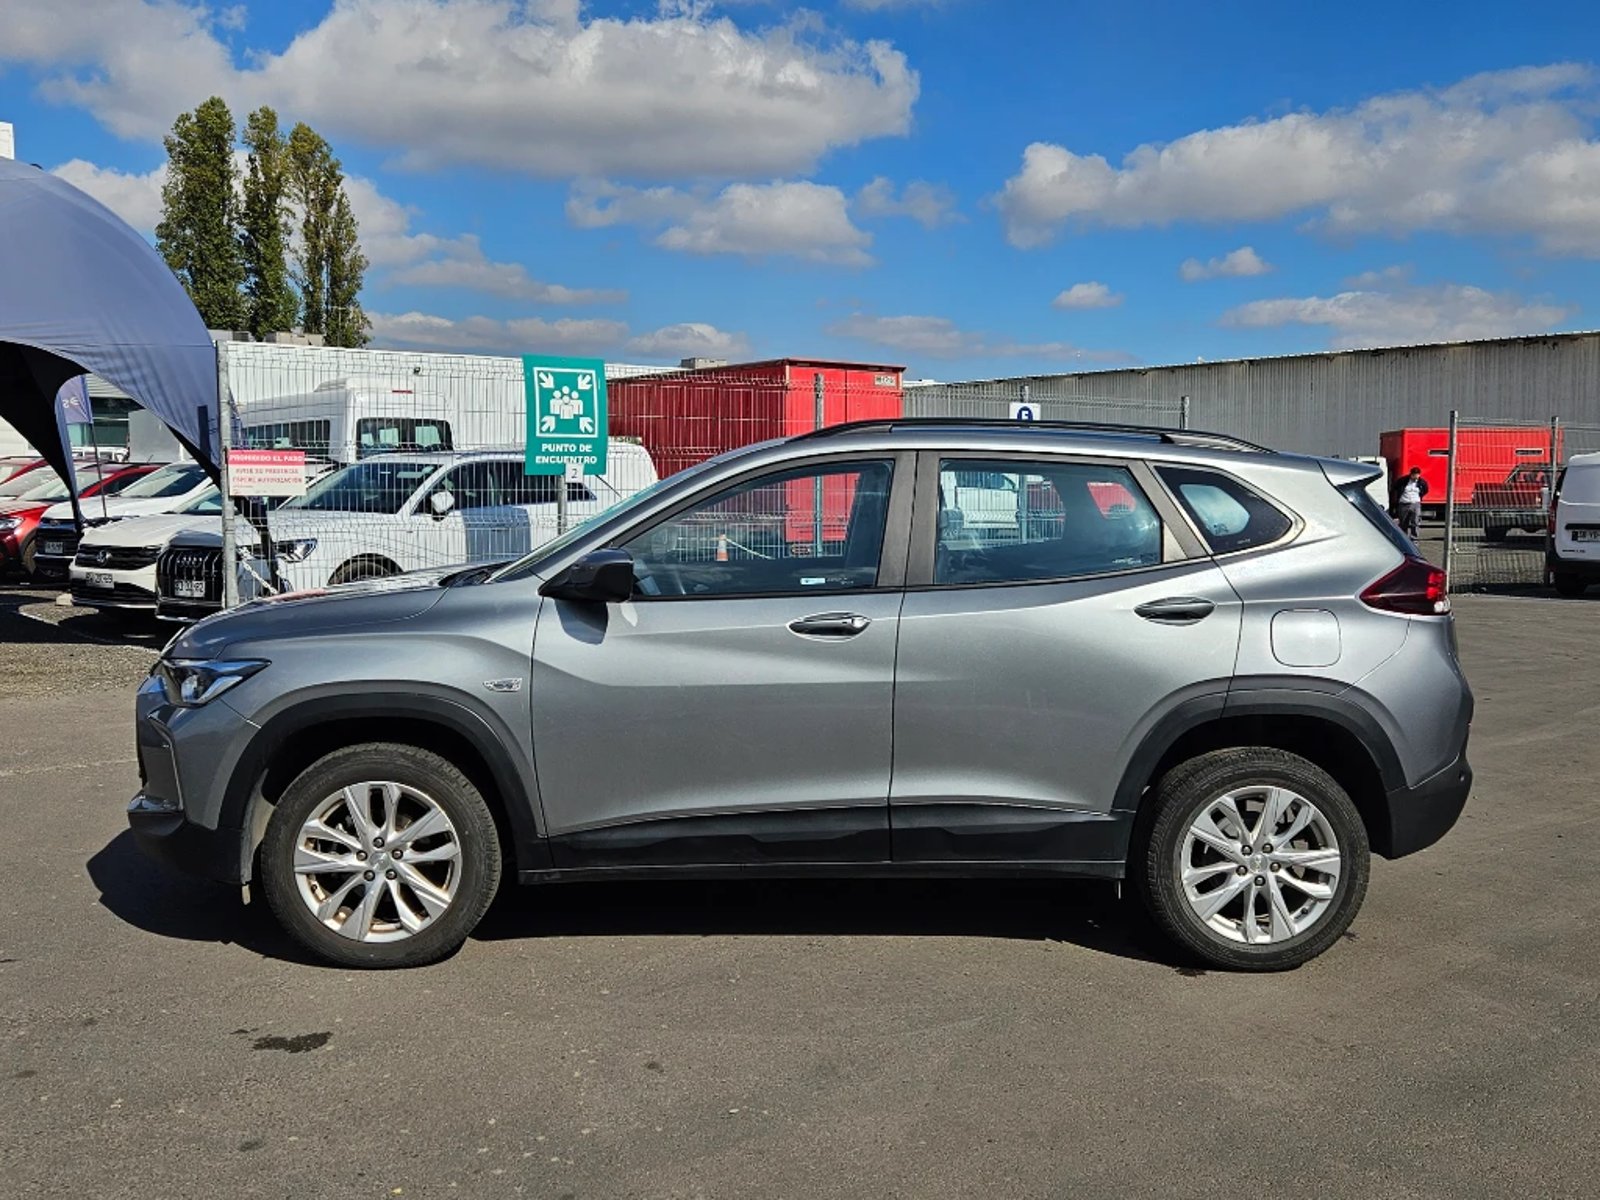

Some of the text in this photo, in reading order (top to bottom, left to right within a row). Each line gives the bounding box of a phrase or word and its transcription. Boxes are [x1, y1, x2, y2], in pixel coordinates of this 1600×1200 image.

[541, 443, 593, 453] PUNTO DE
[535, 455, 598, 465] ENCUENTRO
[571, 468, 578, 479] 2
